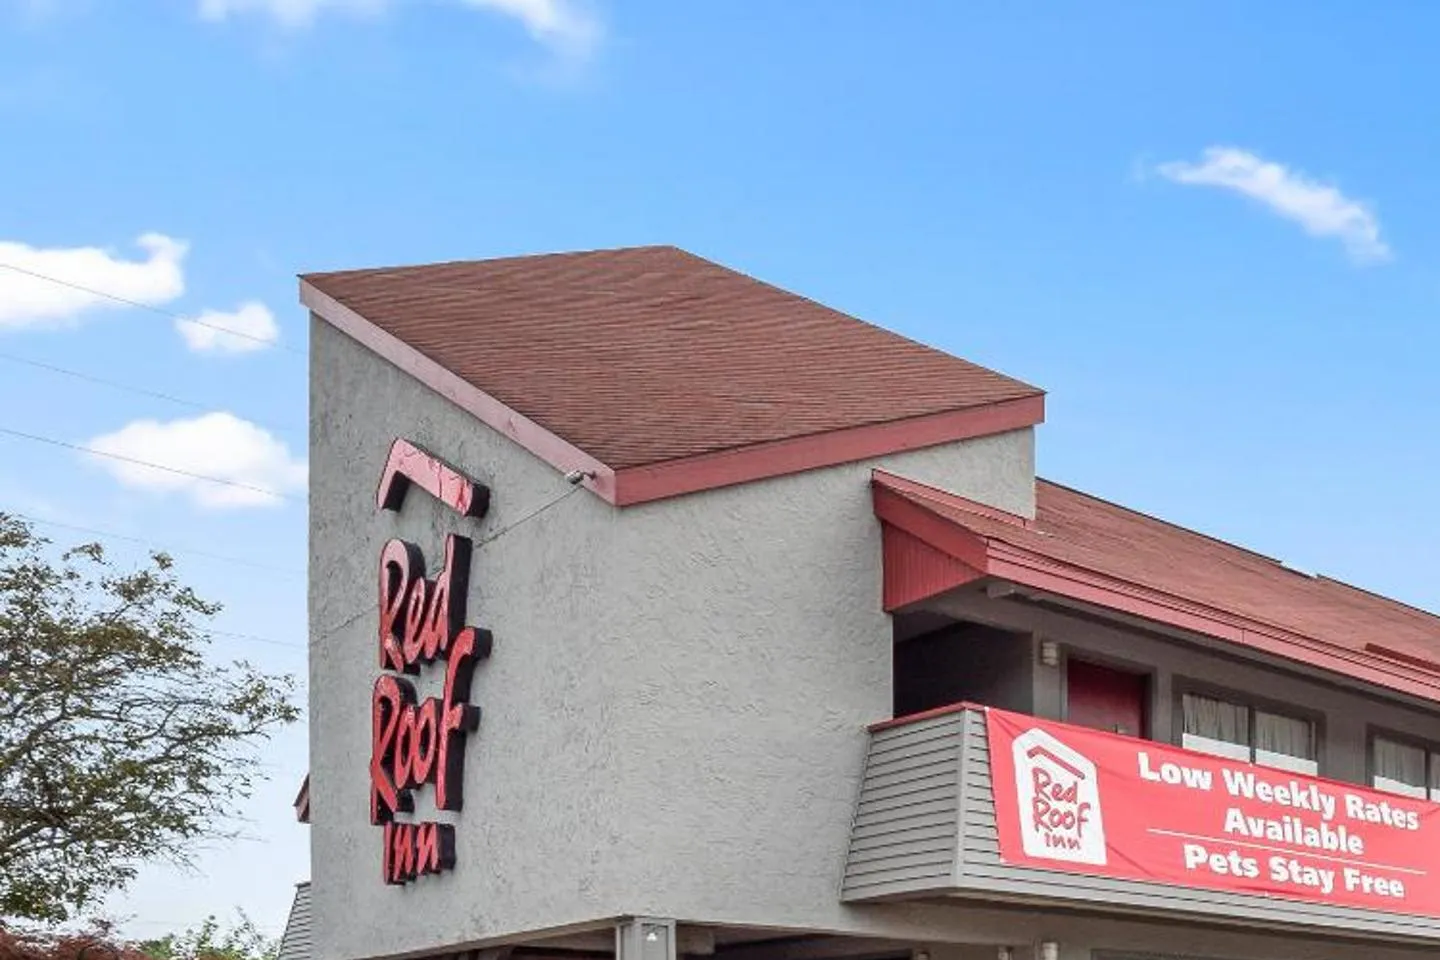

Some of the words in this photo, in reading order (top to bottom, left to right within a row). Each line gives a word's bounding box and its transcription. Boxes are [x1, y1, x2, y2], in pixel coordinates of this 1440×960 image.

[379, 534, 473, 674] Red
[371, 627, 493, 825] Roof
[1032, 767, 1078, 804] Red
[1137, 752, 1213, 790] Low
[1222, 769, 1336, 820] Weekly
[1346, 794, 1419, 832] Rates
[1033, 797, 1091, 838] Roof
[1224, 807, 1364, 855] Available
[1184, 843, 1259, 878] Pets
[1271, 858, 1335, 894] Stay
[1344, 870, 1405, 898] Free
